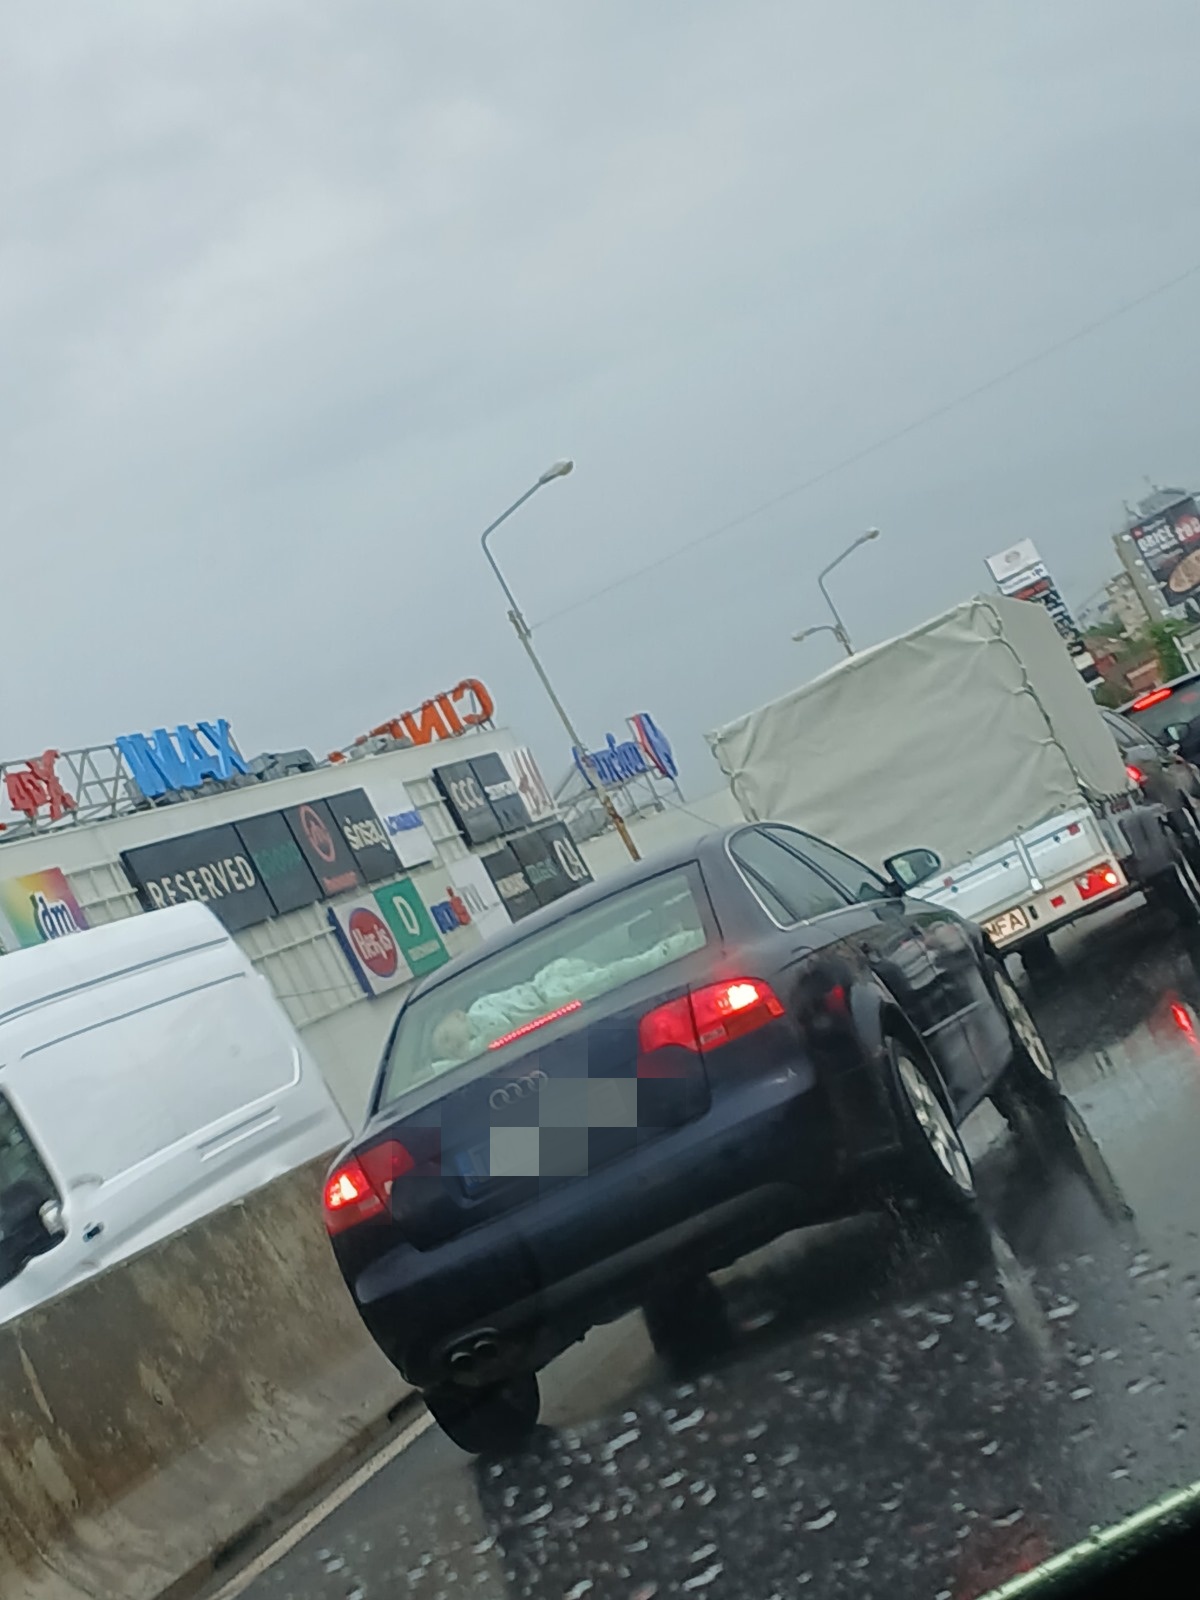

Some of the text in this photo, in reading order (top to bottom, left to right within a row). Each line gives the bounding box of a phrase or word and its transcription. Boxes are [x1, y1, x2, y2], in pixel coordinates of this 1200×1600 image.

[116, 718, 248, 799] IMAX
[450, 777, 485, 812] CCC
[147, 855, 255, 908] RESERVED
[31, 891, 82, 940] dm
